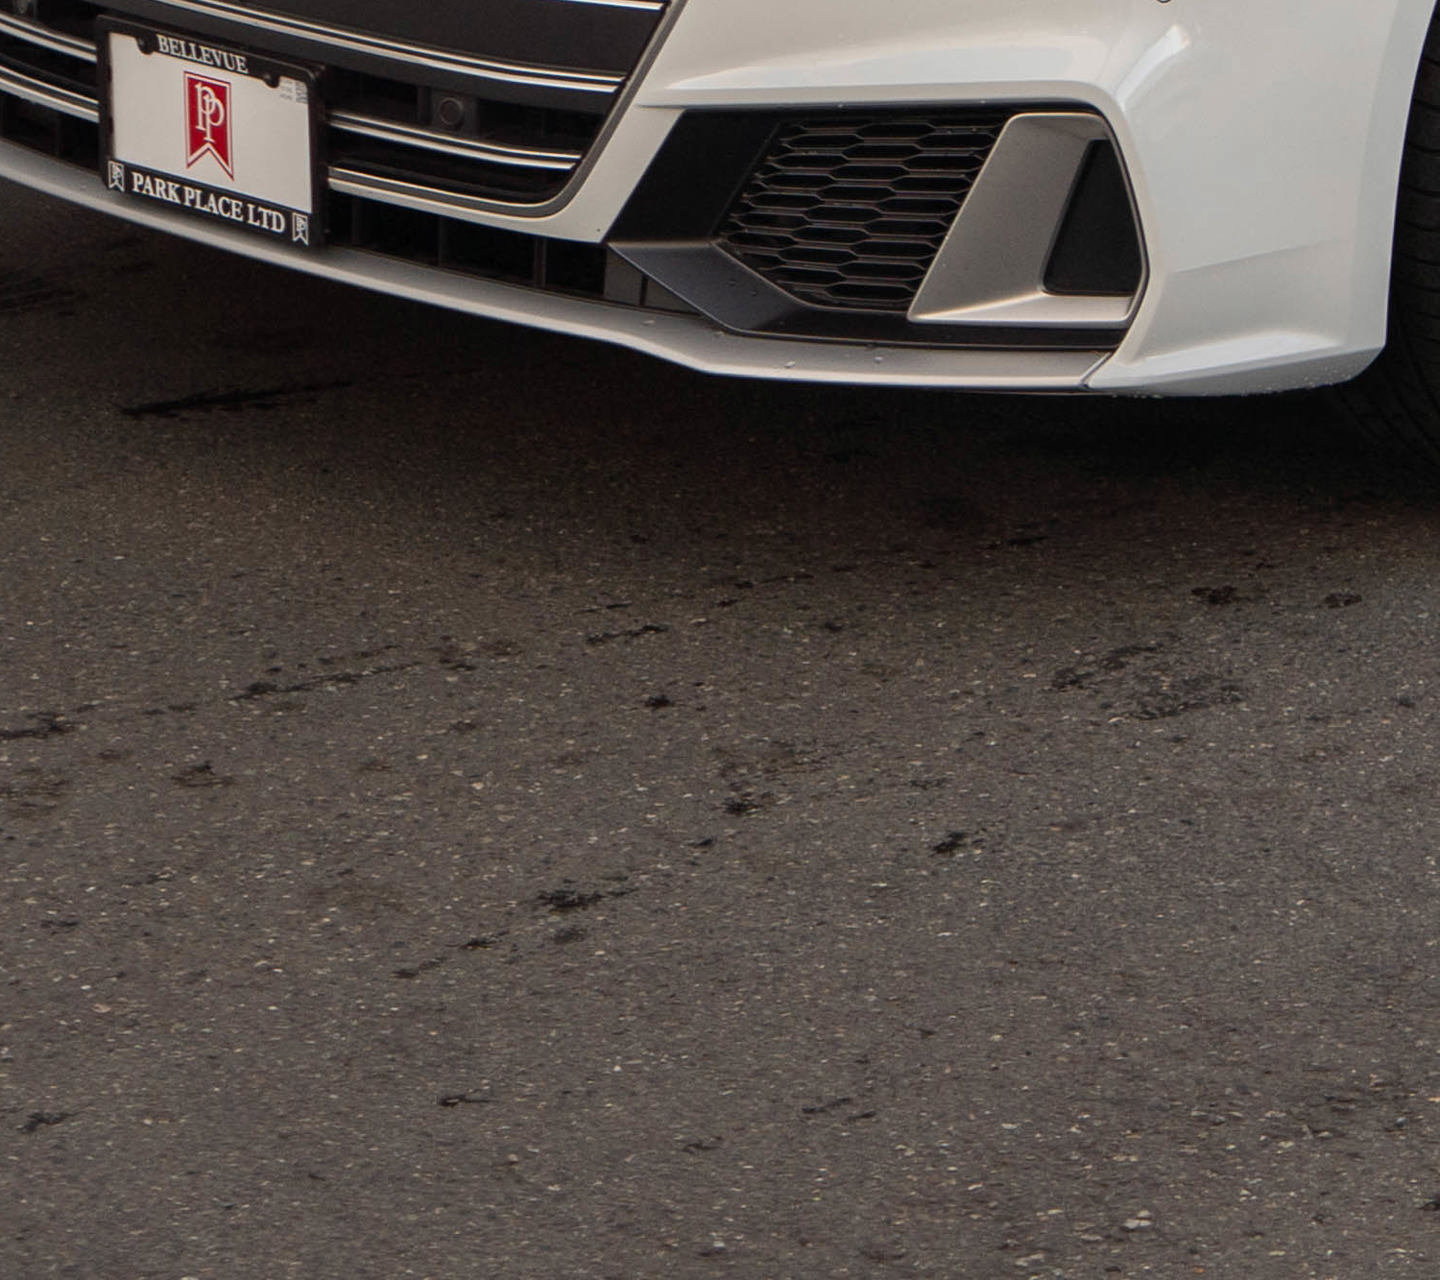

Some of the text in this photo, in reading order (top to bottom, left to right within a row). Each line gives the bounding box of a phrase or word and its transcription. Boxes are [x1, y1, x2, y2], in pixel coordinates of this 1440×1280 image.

[156, 33, 249, 75] BELLEVUE
[131, 171, 181, 204] PARK
[183, 185, 244, 223] PLACE
[247, 204, 286, 234] LTD
